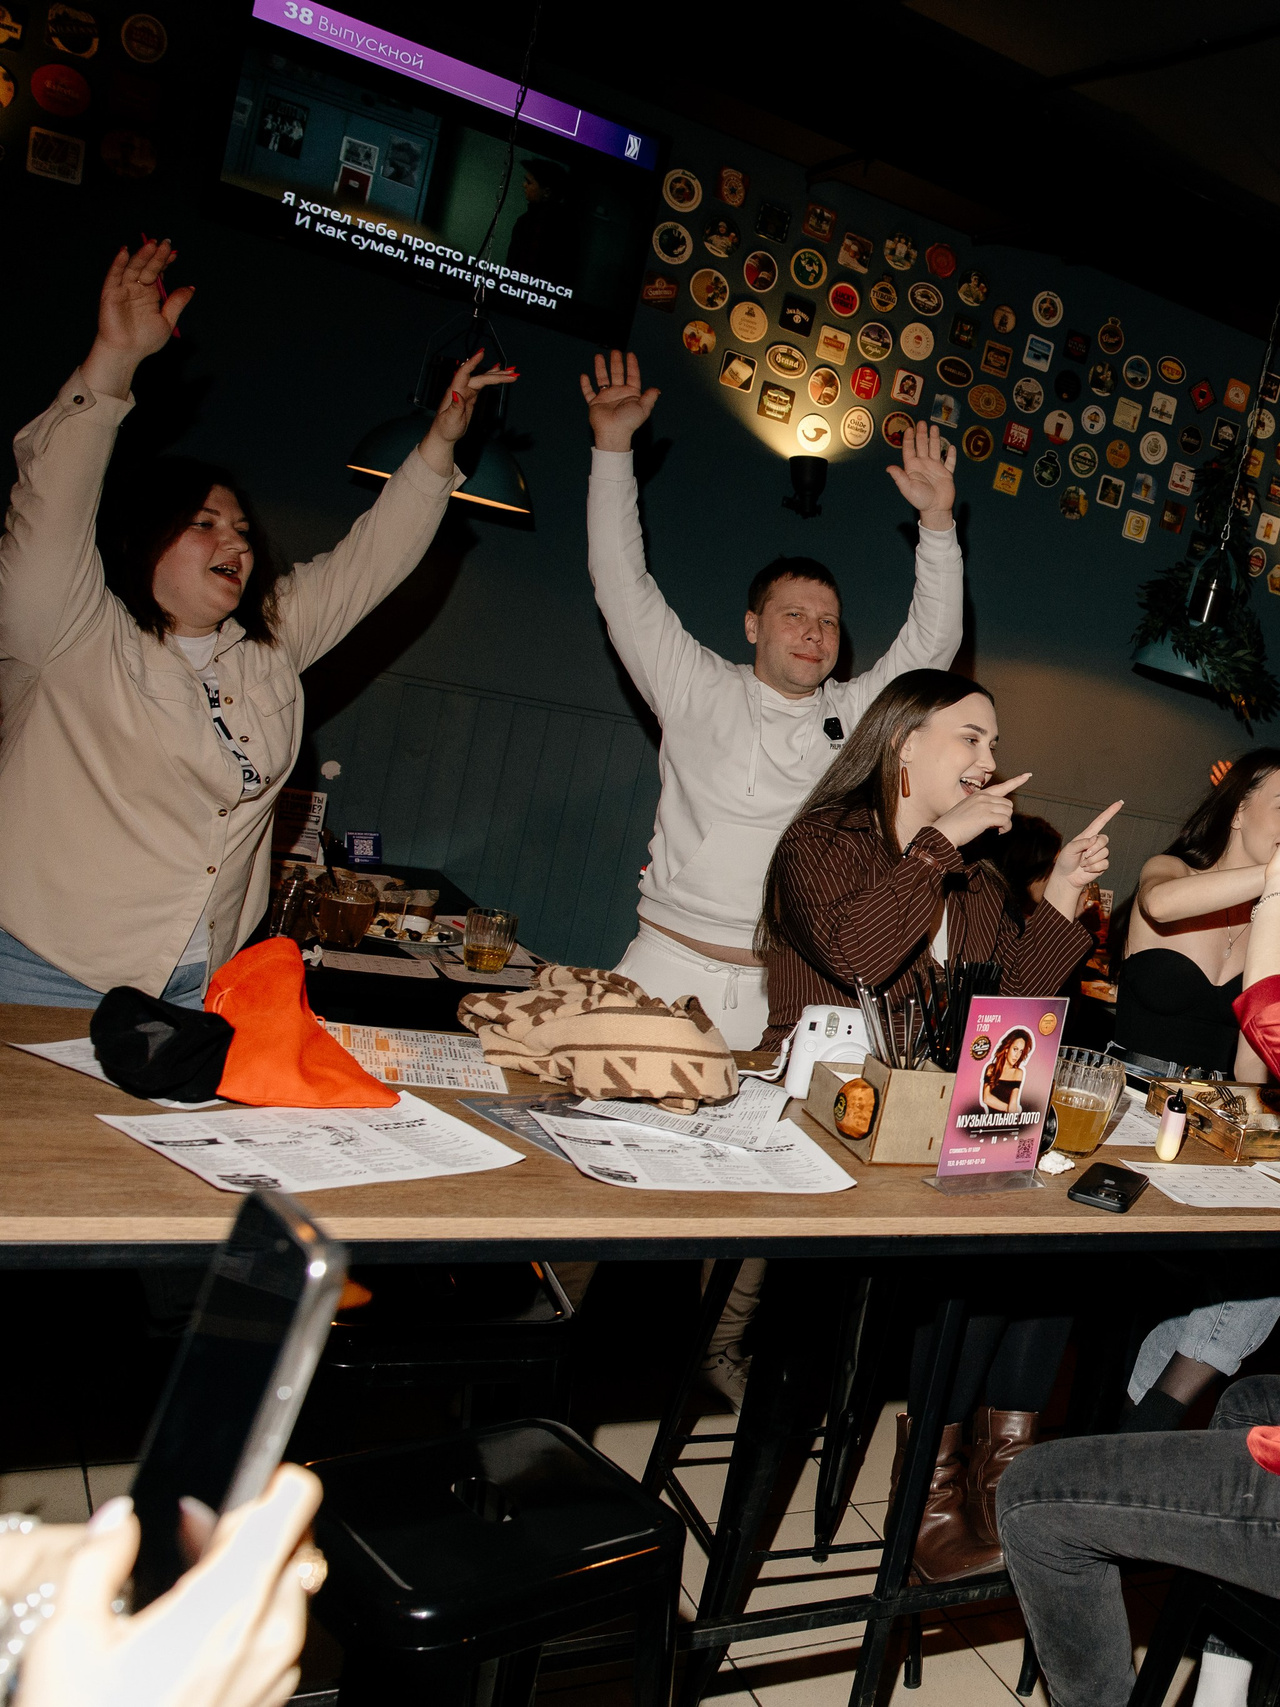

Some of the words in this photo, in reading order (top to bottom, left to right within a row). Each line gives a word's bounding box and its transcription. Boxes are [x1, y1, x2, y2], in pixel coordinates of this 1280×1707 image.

[284, 1, 314, 25] 38
[318, 16, 424, 69] Выпускной
[282, 192, 296, 206] Я
[299, 199, 352, 225] хотел
[356, 218, 398, 240] тебе
[402, 233, 464, 262] просто
[294, 212, 310, 228] И
[315, 222, 348, 242] как
[351, 234, 409, 262] сумел,
[414, 254, 435, 270] на
[499, 283, 557, 310] сыграл
[872, 290, 897, 304] TUBORG
[776, 352, 800, 369] Brand
[314, 796, 324, 804] ТЫ
[977, 1015, 984, 1023] 21
[984, 1014, 1002, 1023] МАРТА
[976, 1024, 990, 1032] 17:00
[956, 1113, 1018, 1128] МУЗЫКАЛЬНОЕ
[1018, 1112, 1041, 1125] ЛОТО
